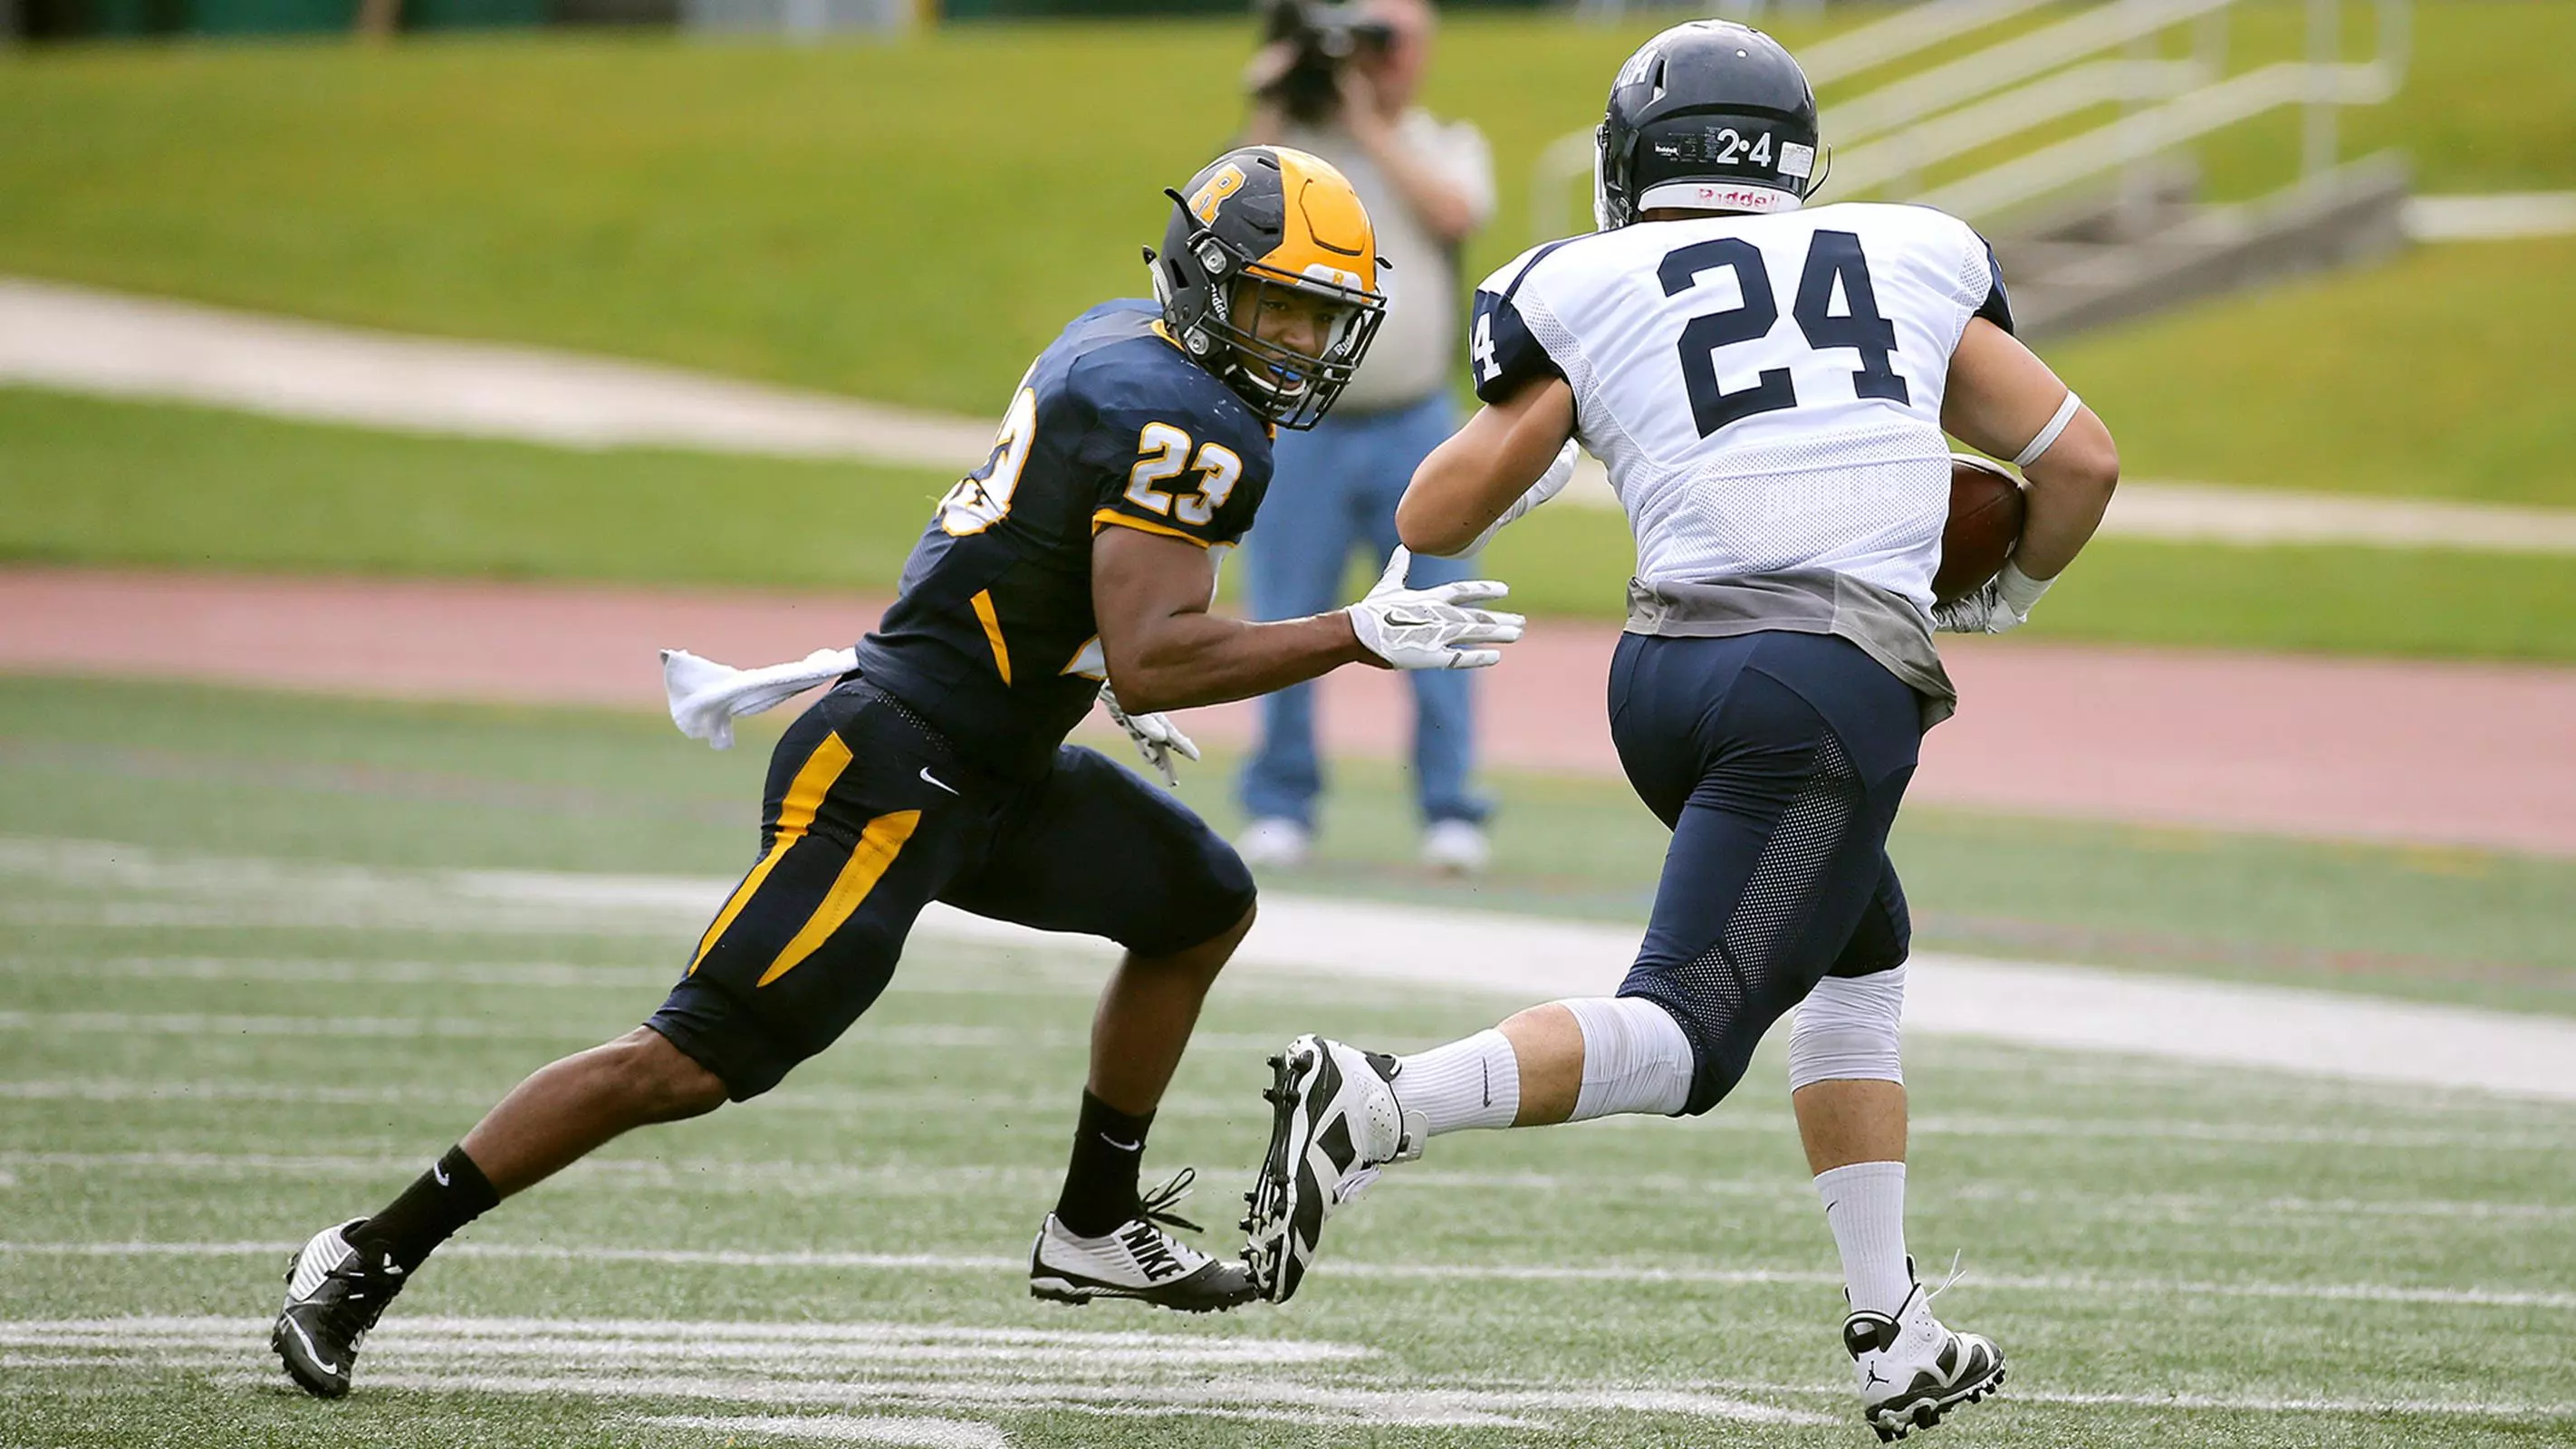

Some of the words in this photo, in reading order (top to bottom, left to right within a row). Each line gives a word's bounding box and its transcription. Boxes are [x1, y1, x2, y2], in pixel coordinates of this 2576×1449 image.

[1187, 162, 1247, 228] R
[1469, 312, 1504, 389] 4
[1657, 229, 1911, 440] 24
[1123, 421, 1244, 526] 23
[1120, 1225, 1186, 1282] NIKE
